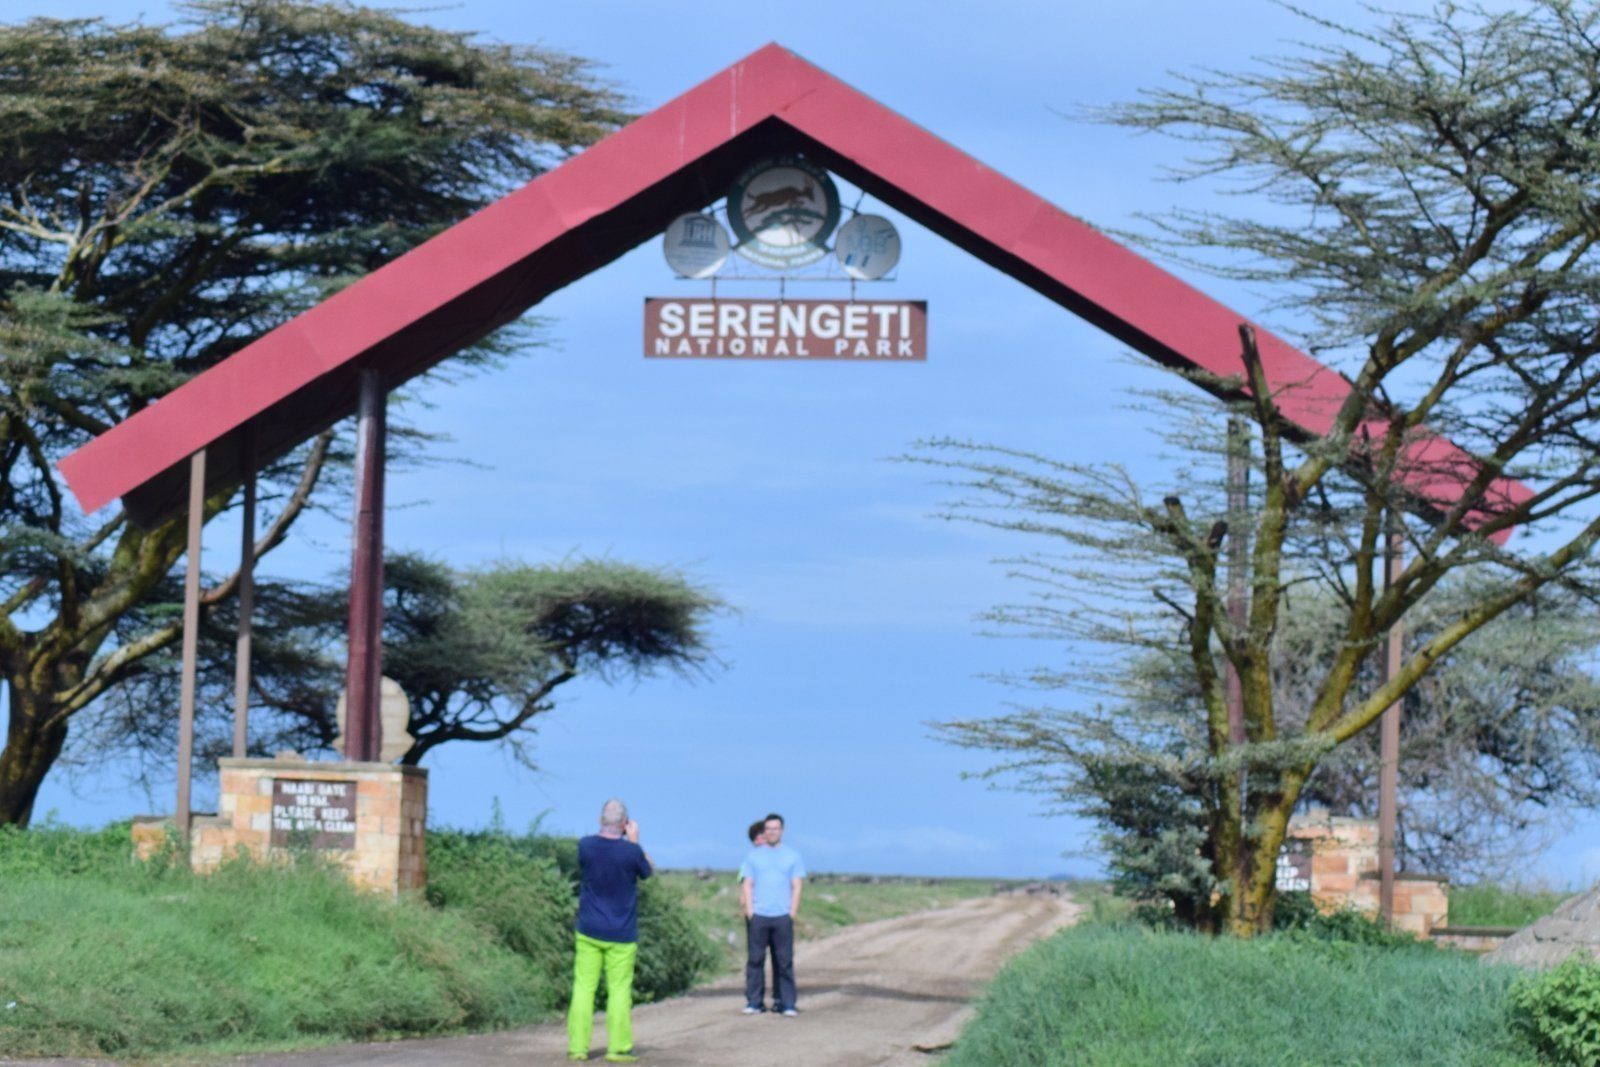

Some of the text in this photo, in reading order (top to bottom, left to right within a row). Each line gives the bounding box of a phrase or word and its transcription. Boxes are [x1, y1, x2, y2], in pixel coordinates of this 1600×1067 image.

[659, 303, 910, 338] SERENGETI
[655, 338, 913, 356] NATIONAL PARK
[318, 784, 346, 797] GATE
[274, 805, 349, 820] PLEASE KEEP
[324, 821, 355, 833] CLEAN
